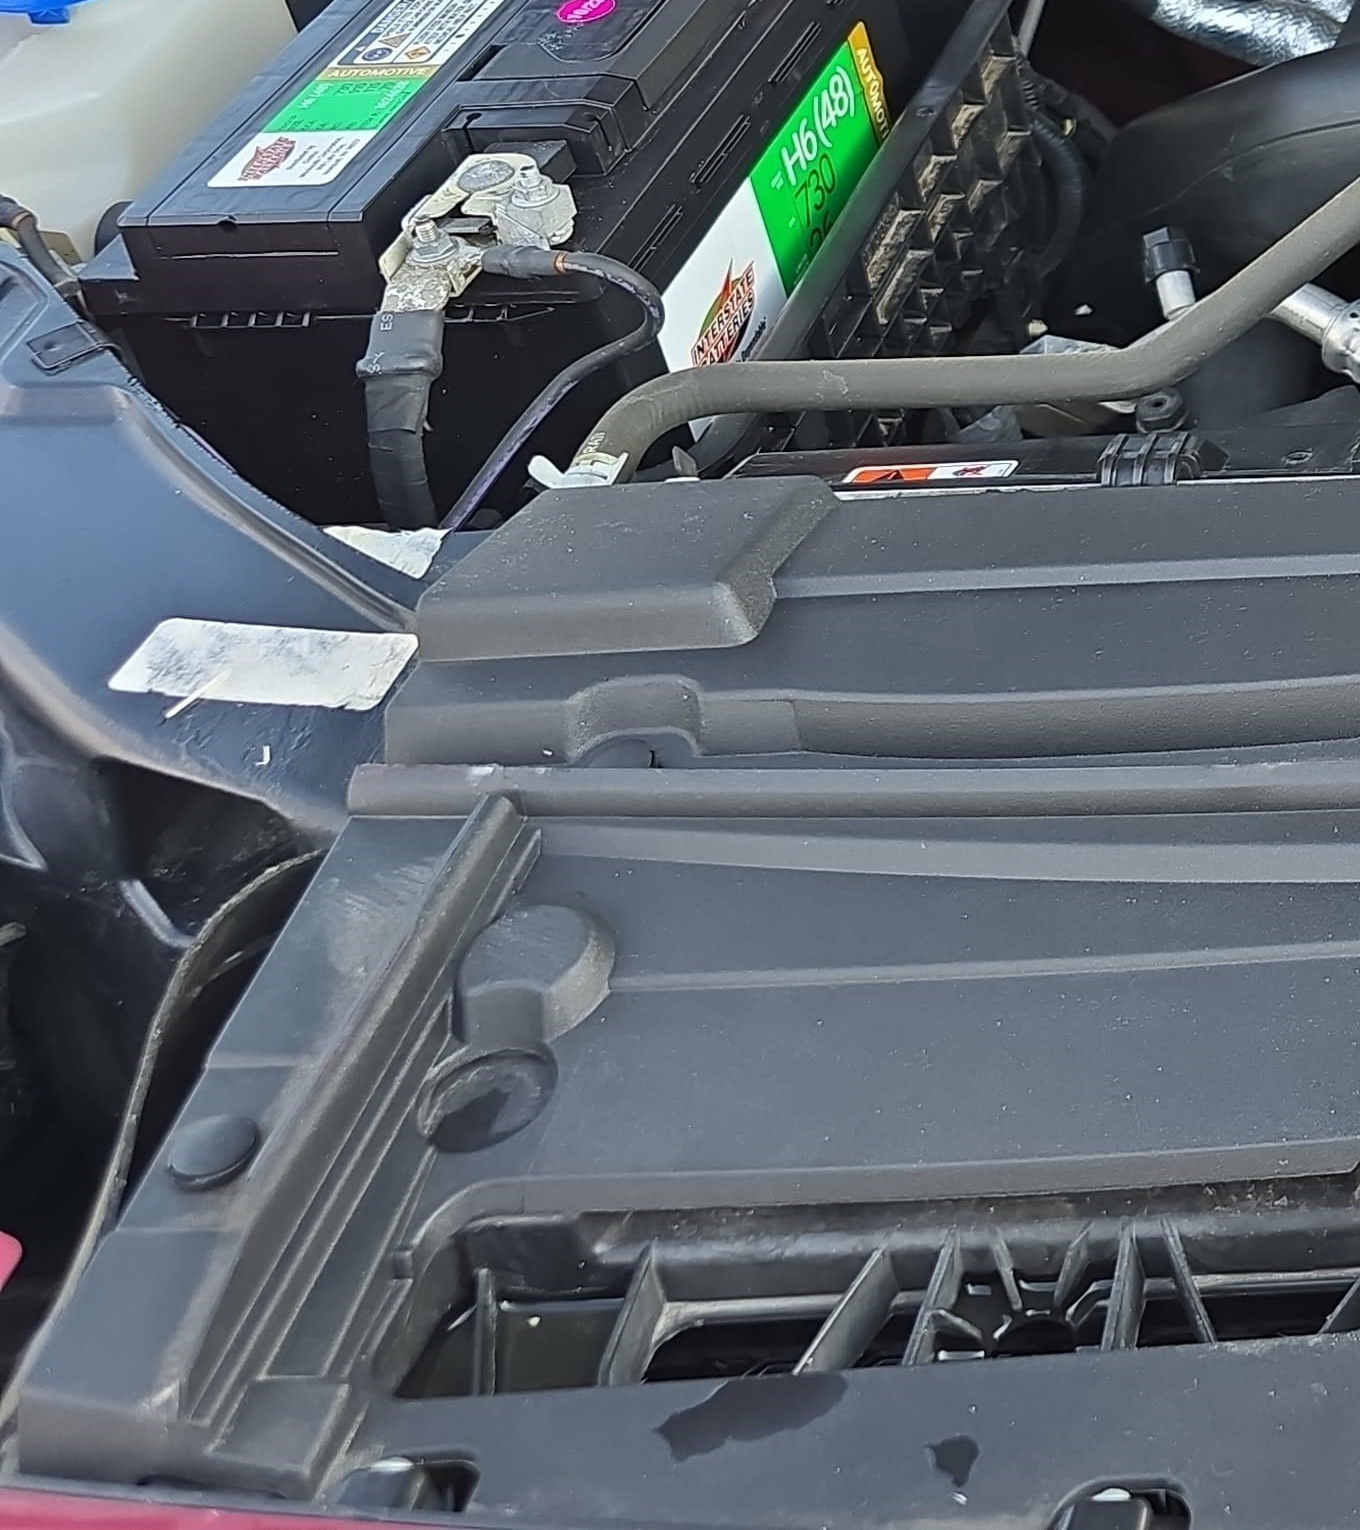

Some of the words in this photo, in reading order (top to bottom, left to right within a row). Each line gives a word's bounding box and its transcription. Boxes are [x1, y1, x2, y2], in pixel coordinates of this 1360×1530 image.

[328, 68, 426, 79] AUTOMOTIVE
[794, 152, 837, 228] 730
[692, 270, 754, 365] INTERSTATE
